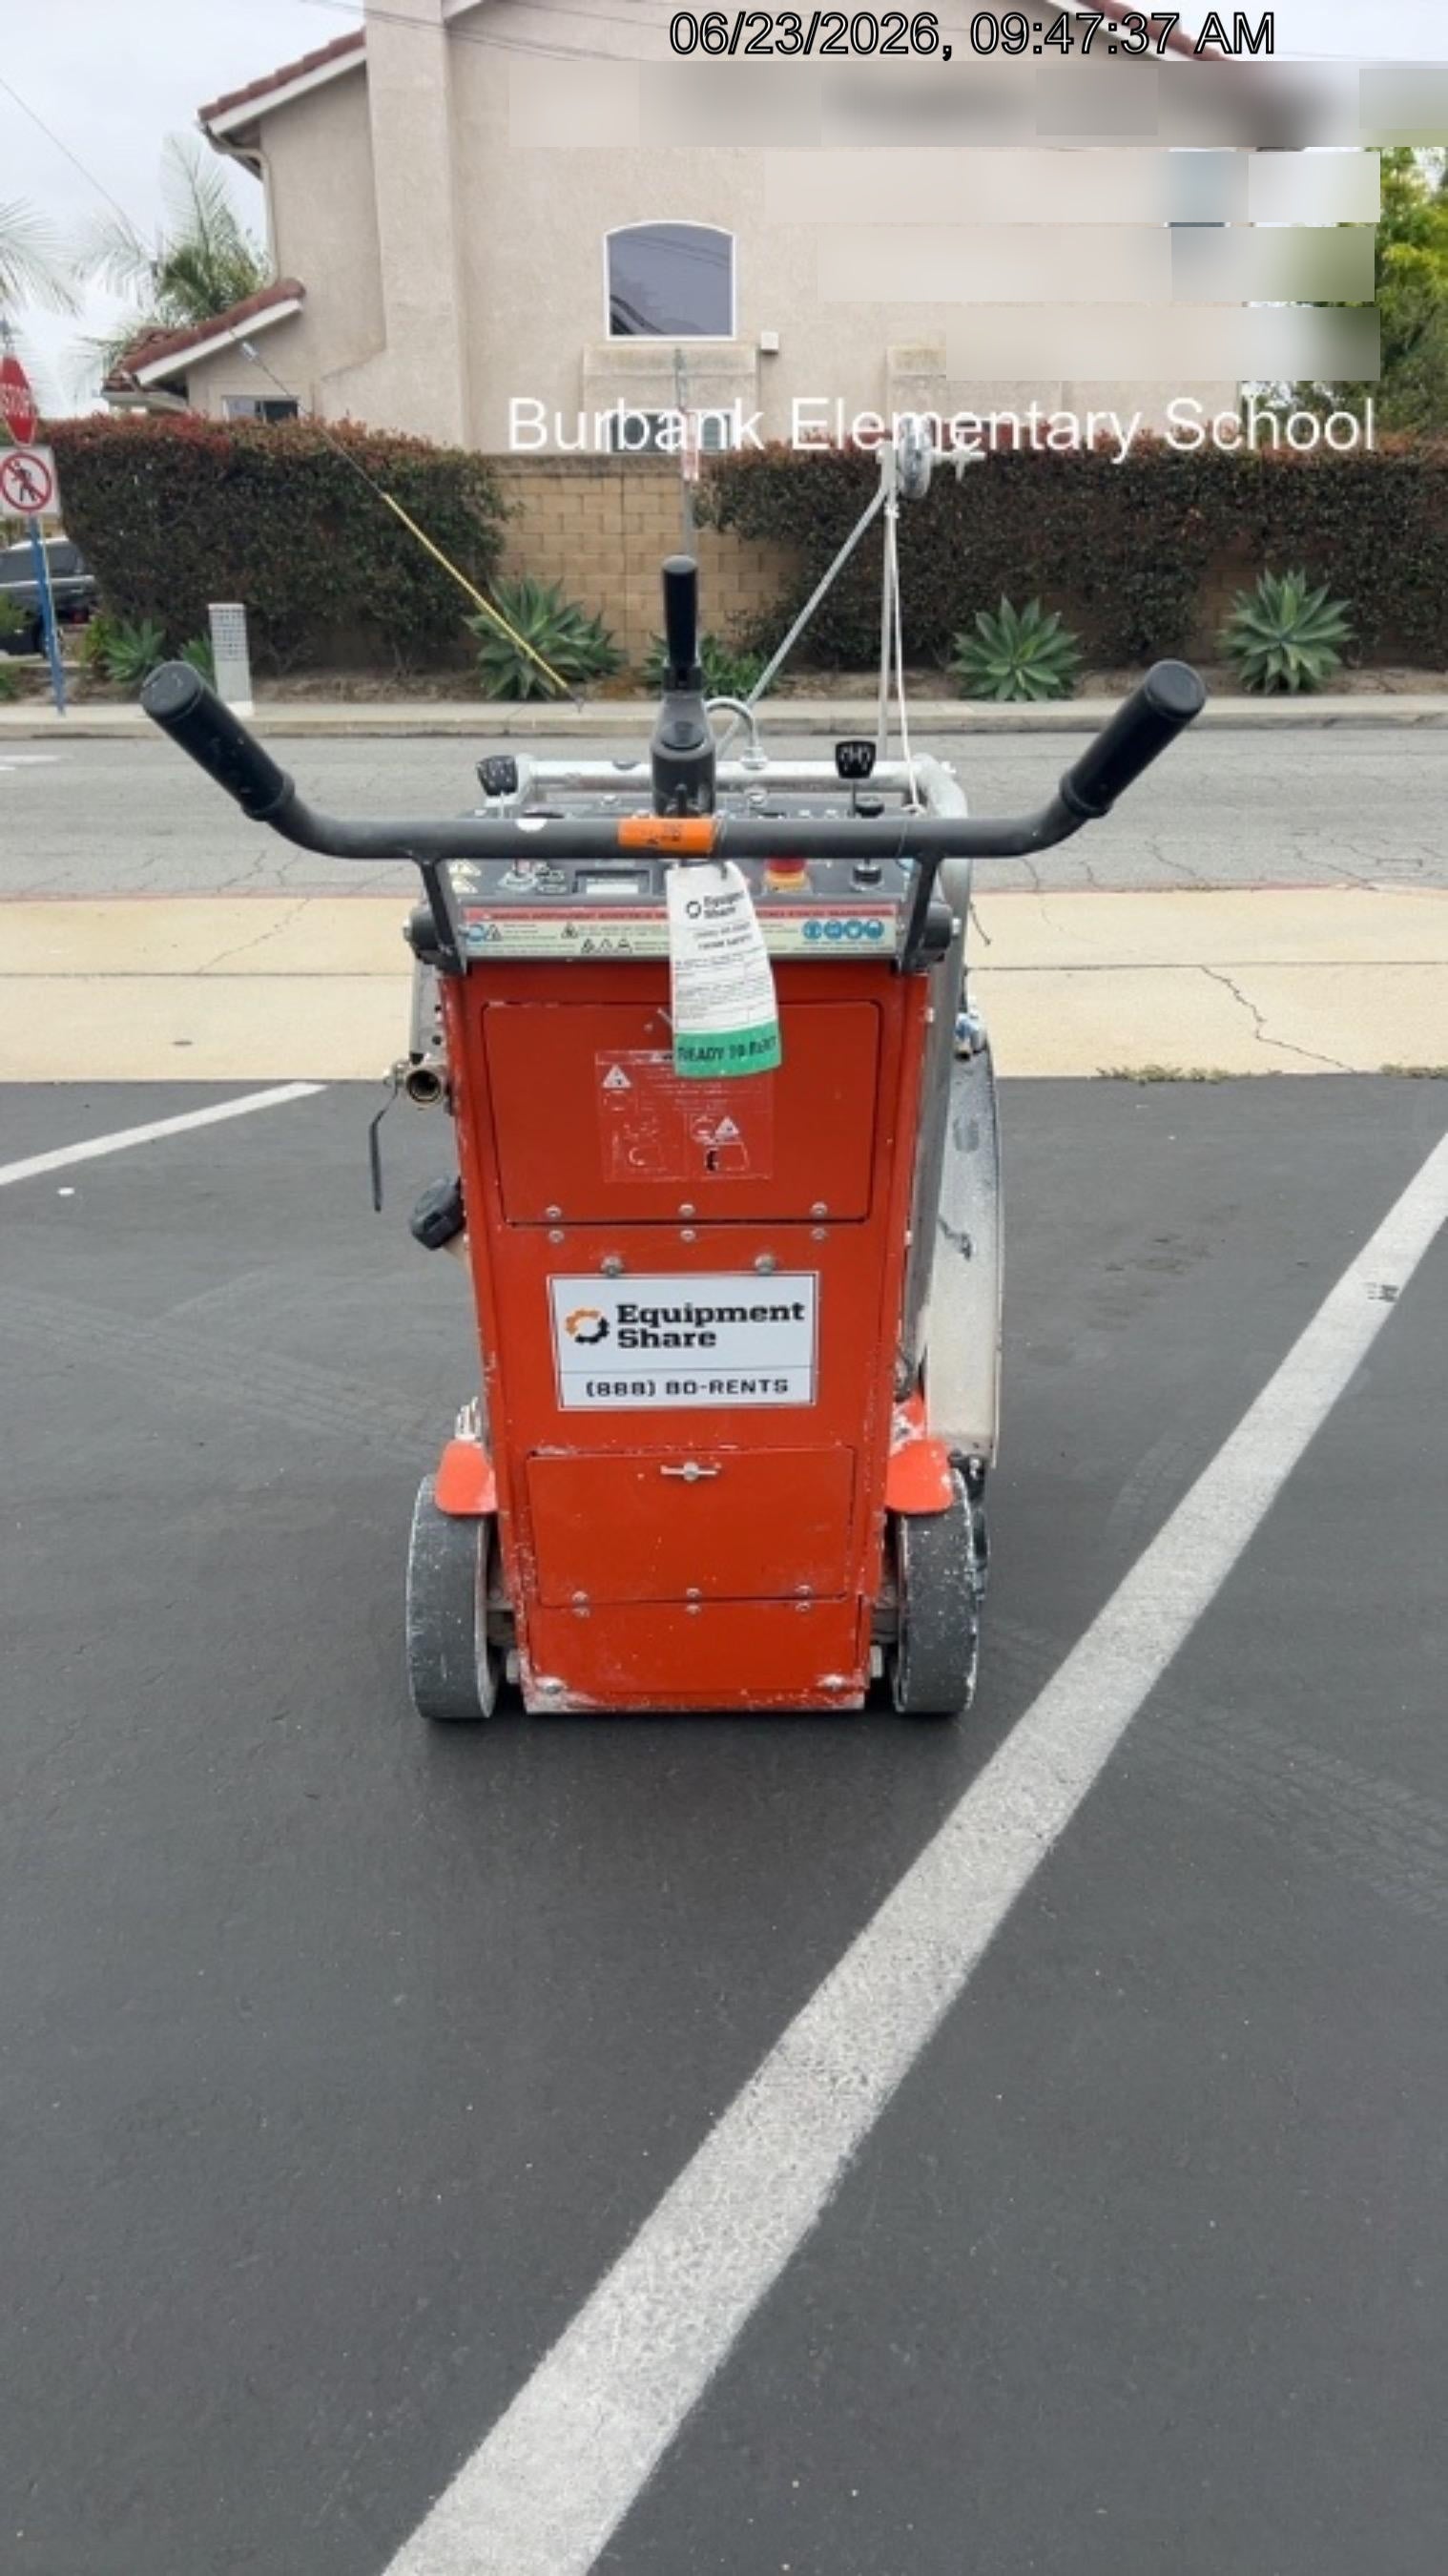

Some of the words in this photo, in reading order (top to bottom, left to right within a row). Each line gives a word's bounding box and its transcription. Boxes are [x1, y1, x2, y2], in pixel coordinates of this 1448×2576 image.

[616, 1302, 805, 1328] Equipment
[617, 1328, 717, 1349] Share
[586, 1380, 656, 1398] (888)
